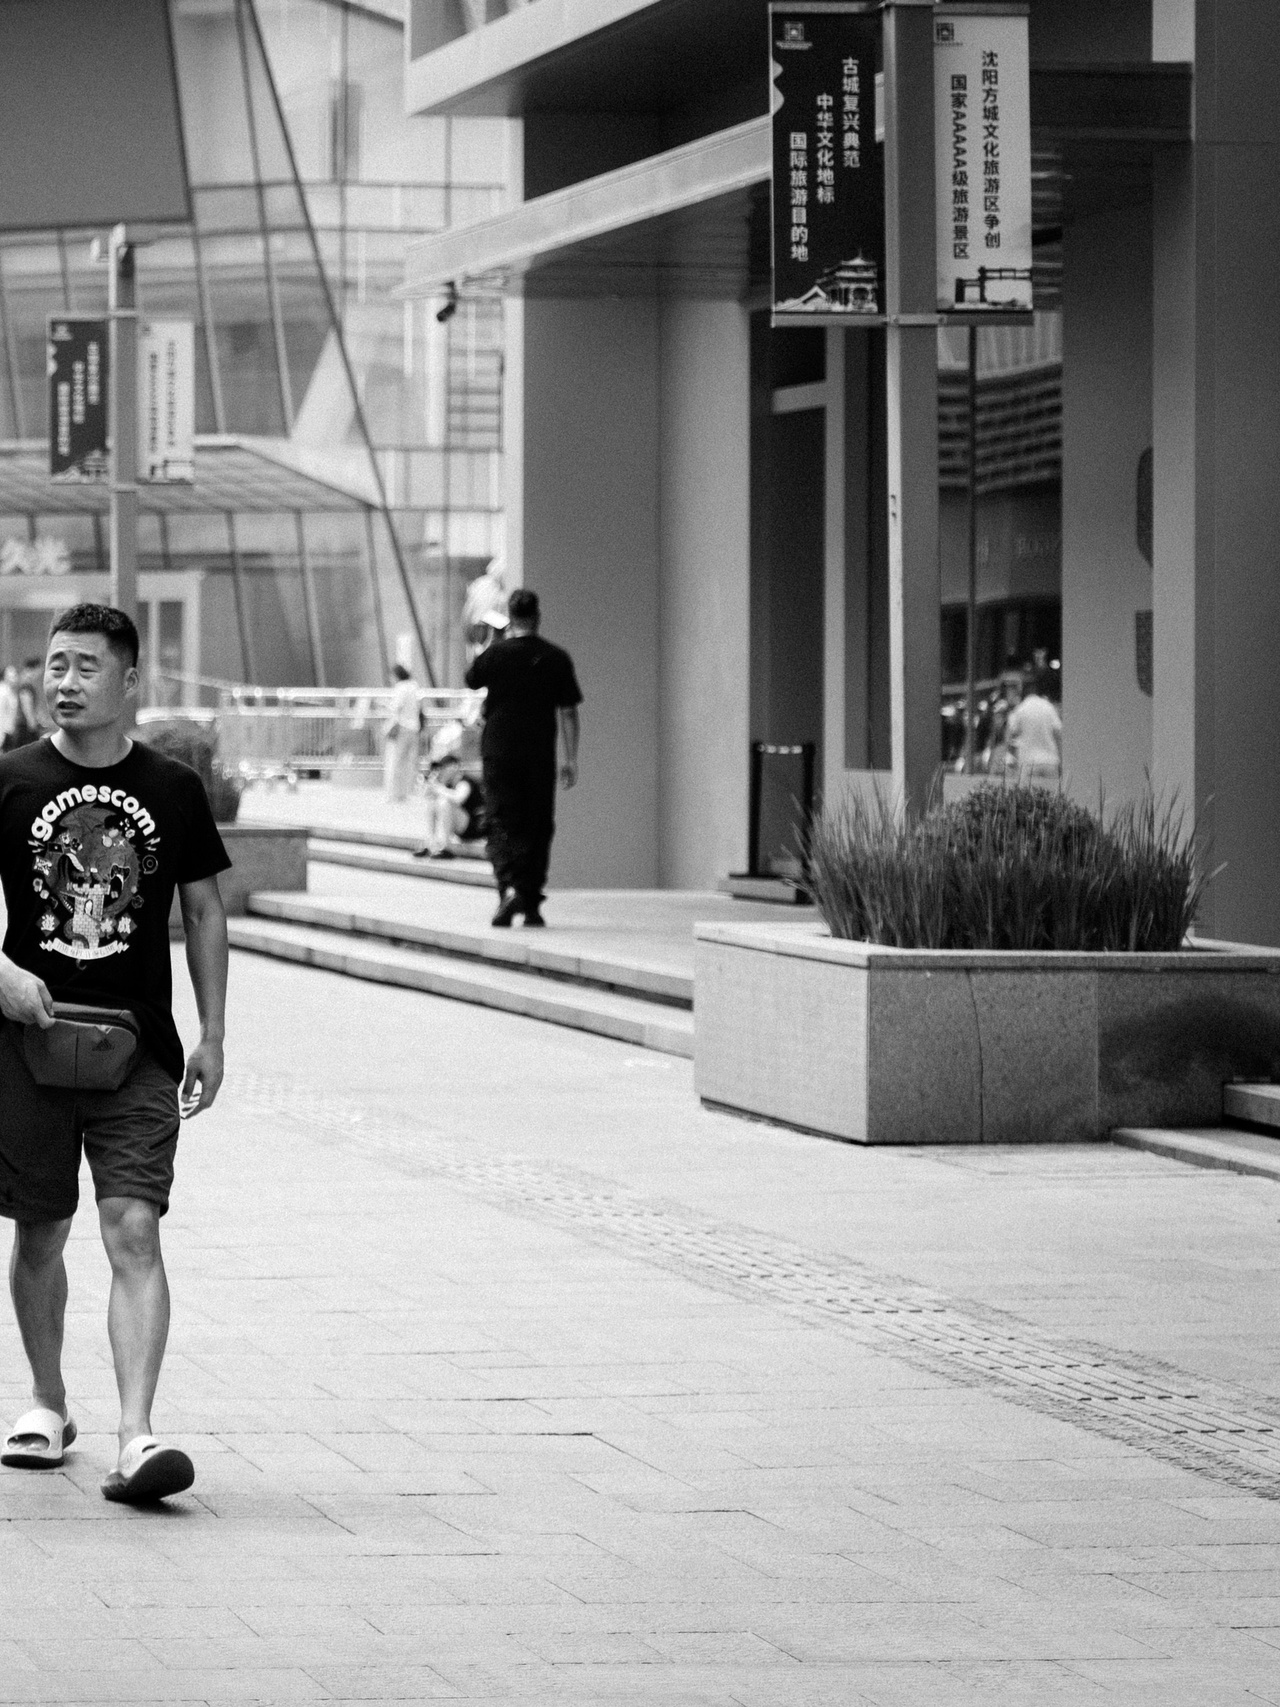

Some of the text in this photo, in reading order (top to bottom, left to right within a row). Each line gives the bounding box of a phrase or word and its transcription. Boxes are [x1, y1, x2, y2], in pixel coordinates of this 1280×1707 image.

[816, 93, 835, 205] 中华文化地标
[842, 57, 861, 168] 古城复兴典范
[951, 74, 970, 260] 国家AAAAA级旅游景区
[982, 51, 1001, 249] 沈阳方城文化旅游区争创
[789, 132, 808, 262] 国际旅游目的地
[31, 784, 156, 842] gamescom
